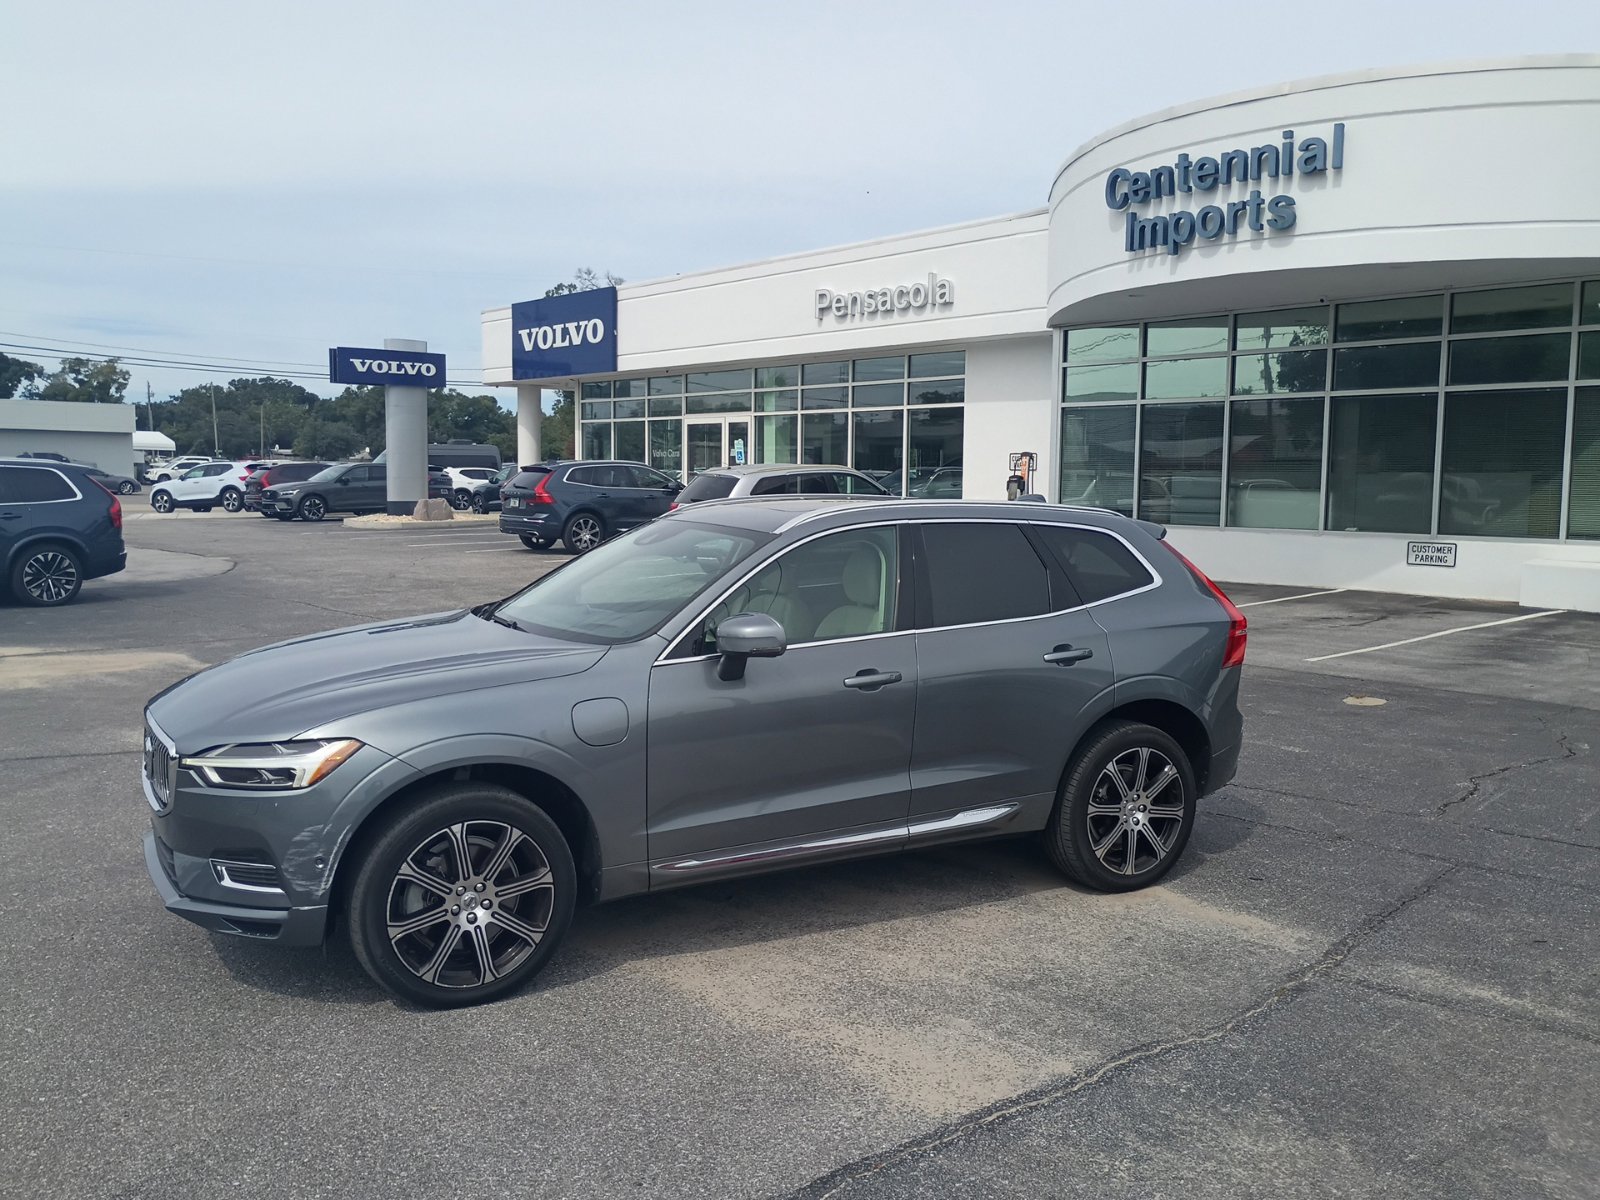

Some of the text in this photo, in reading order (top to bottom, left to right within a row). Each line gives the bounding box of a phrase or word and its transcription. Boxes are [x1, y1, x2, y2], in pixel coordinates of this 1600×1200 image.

[1105, 123, 1345, 210] Centennial
[1125, 190, 1297, 256] Imports
[815, 272, 954, 320] Pensacola
[518, 318, 604, 352] VOLVO
[349, 358, 436, 377] VOLVO
[1412, 545, 1452, 554] CUSTOMER
[1415, 554, 1448, 563] PARKING
